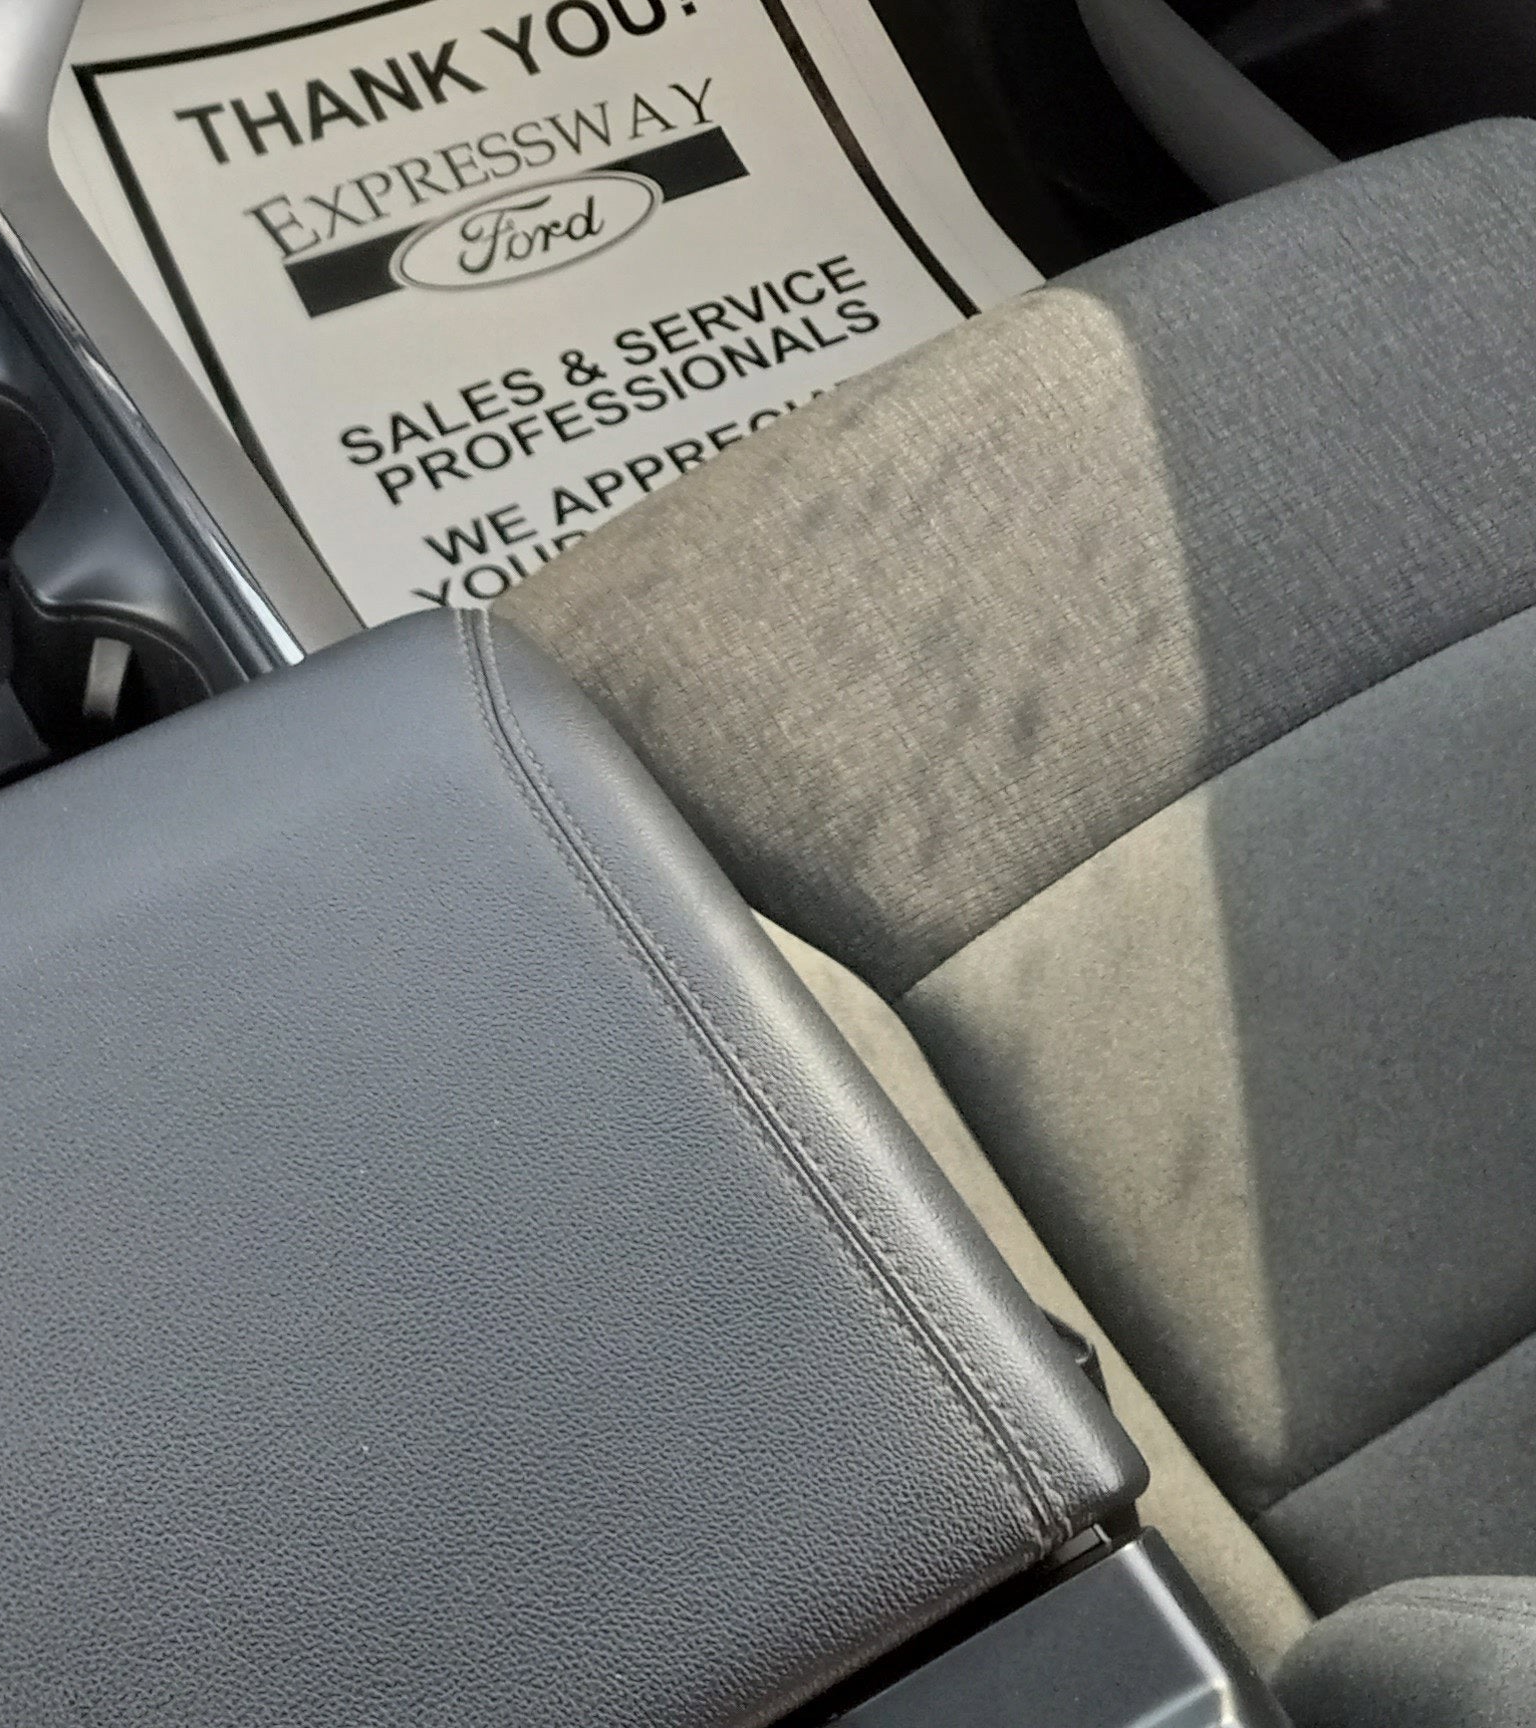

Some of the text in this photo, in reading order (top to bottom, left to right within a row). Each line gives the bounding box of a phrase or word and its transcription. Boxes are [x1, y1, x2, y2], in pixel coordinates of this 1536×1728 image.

[175, 38, 488, 168] THANK
[242, 76, 719, 264] EXPRESSWAY
[457, 196, 607, 277] Ford
[338, 254, 869, 469] SALES & SERVICE
[374, 297, 883, 508] PROFESSIONALS
[421, 379, 849, 567] WE APPRE
